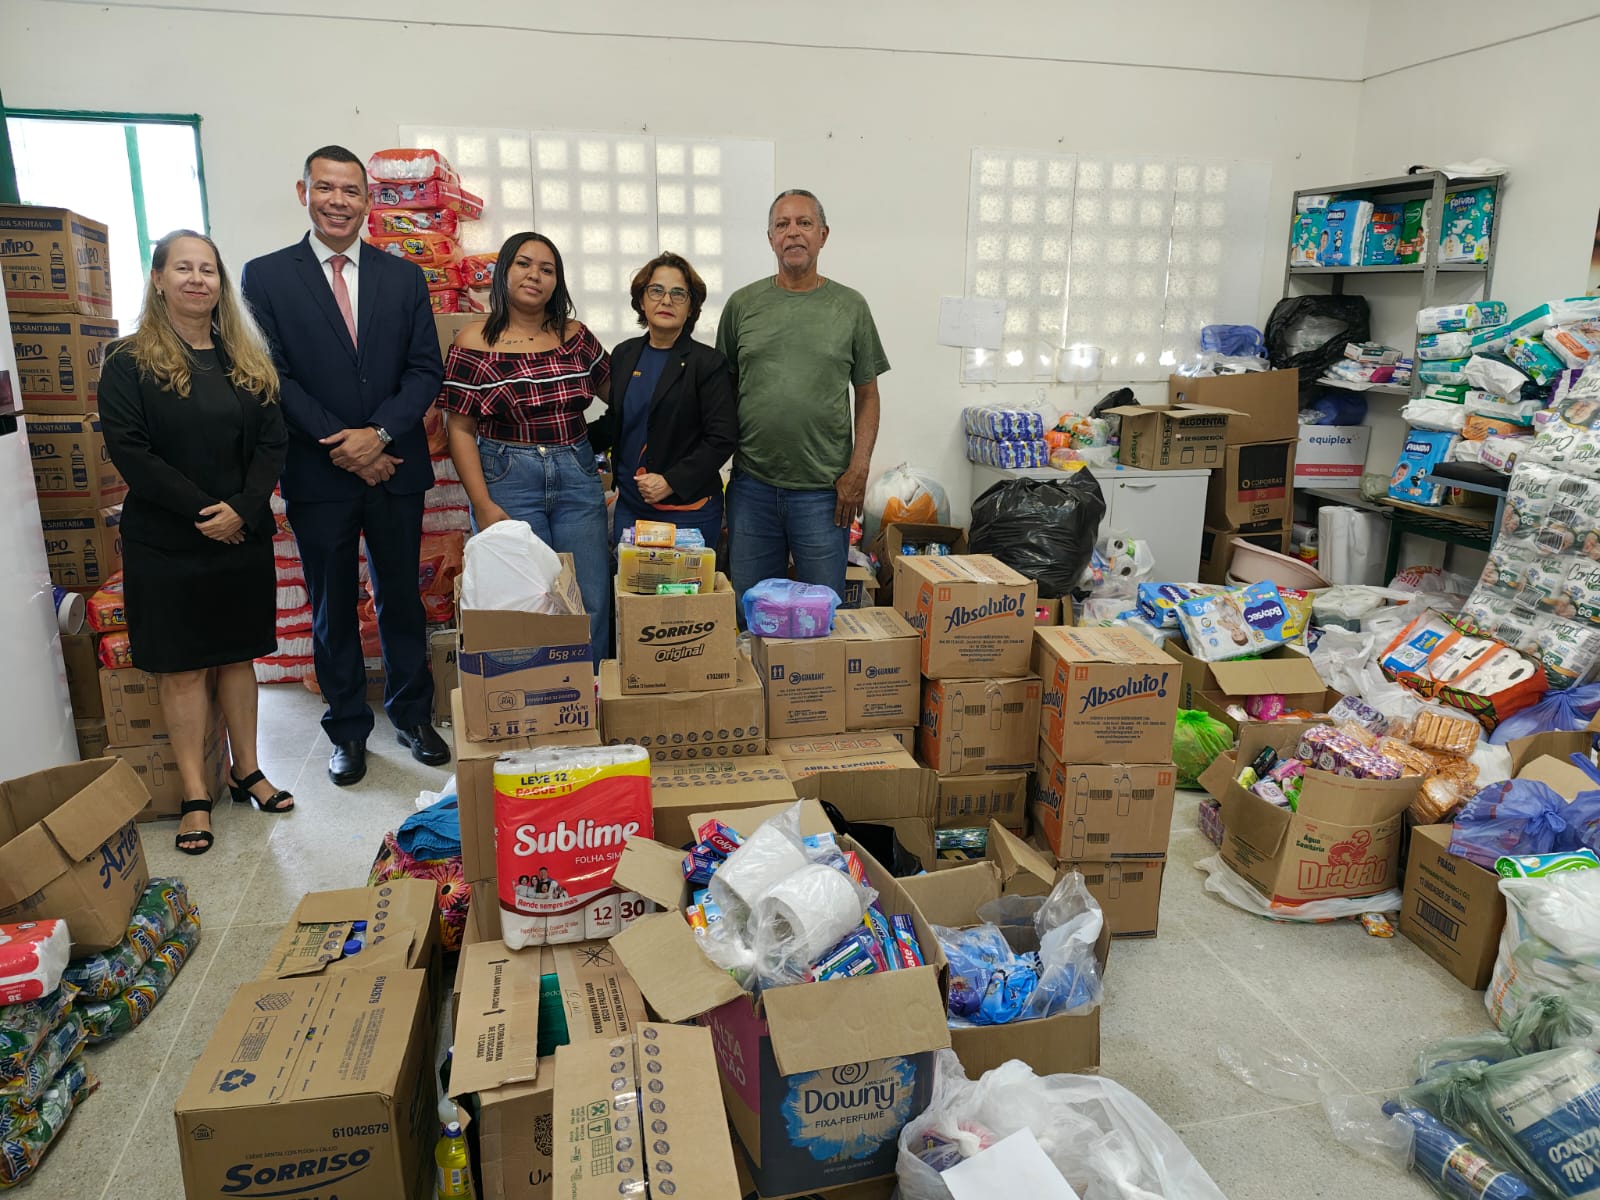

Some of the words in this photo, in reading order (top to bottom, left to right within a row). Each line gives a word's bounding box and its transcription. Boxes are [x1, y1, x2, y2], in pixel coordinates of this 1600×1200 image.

[1309, 435, 1352, 446] equiplex
[1406, 443, 1430, 452] PANDA
[1522, 515, 1534, 525] GG
[1568, 563, 1600, 583] Confo
[944, 592, 1026, 633] Absoluto!
[1247, 606, 1283, 622] Babysec
[1578, 607, 1592, 618] GG
[638, 621, 715, 642] SORRISO
[548, 649, 569, 660] 85g
[655, 644, 705, 662] Original
[1543, 655, 1556, 665] GG
[1079, 672, 1168, 714] Absoluto!
[554, 711, 588, 728] flor
[521, 774, 550, 786] LEVE
[554, 773, 568, 782] 12
[516, 786, 556, 798] PAGUE
[560, 785, 573, 794] 11
[514, 820, 640, 856] Sublime
[712, 835, 737, 852] Colga
[576, 855, 604, 864] FOLHA
[1298, 855, 1389, 890] Dragão
[518, 899, 538, 908] Rende
[540, 902, 564, 911] sempre
[594, 906, 612, 920] 12
[620, 899, 646, 919] 30
[586, 982, 594, 996] LUGAR
[590, 1004, 603, 1034] CONSERVAR
[714, 1021, 744, 1064] ALTA
[864, 1077, 894, 1086] AMACIANTE
[804, 1084, 895, 1114] Downy
[815, 1111, 886, 1128] FIXA-PERFUME
[332, 1123, 389, 1138] 61042679
[220, 1149, 370, 1192] SORRISO
